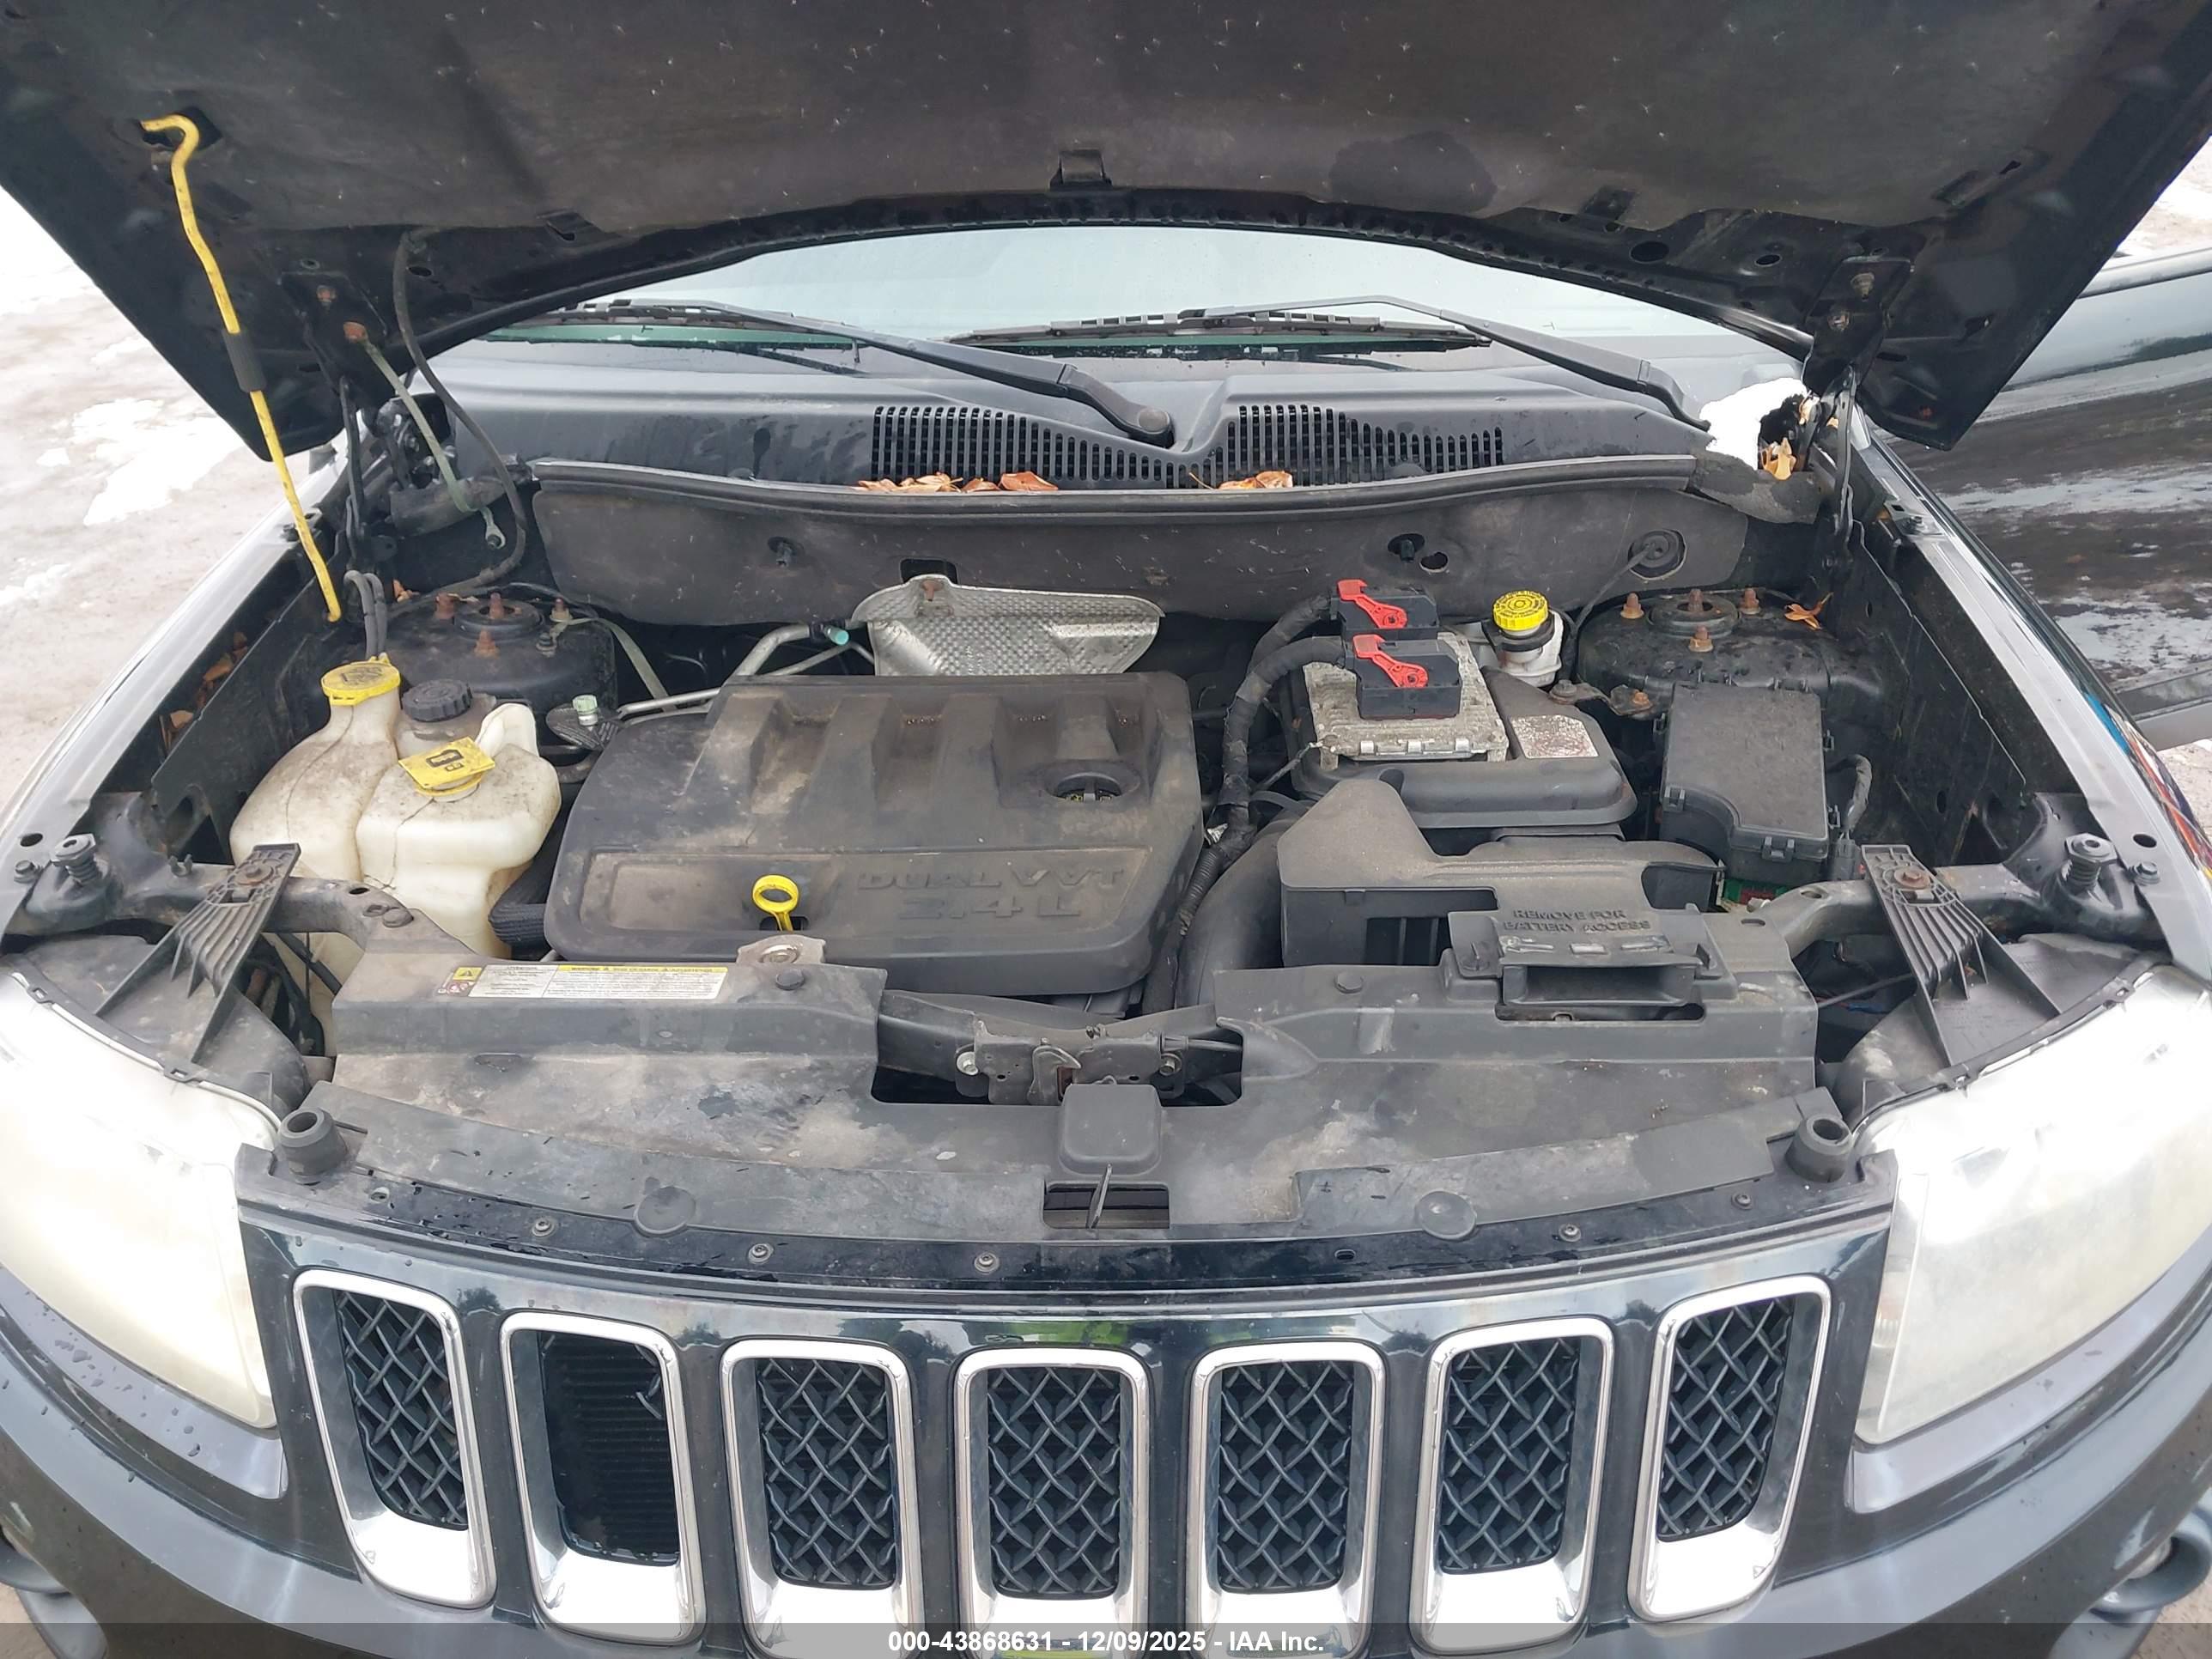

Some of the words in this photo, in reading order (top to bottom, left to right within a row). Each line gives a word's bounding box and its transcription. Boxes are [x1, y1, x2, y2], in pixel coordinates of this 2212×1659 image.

[858, 872, 1001, 889] DUAL
[1010, 868, 1124, 888] VVT
[1513, 909, 1587, 921] REMOVE
[1589, 908, 1626, 920] FOR
[1503, 921, 1574, 933] BATTERY
[1582, 921, 1651, 933] ACCESS
